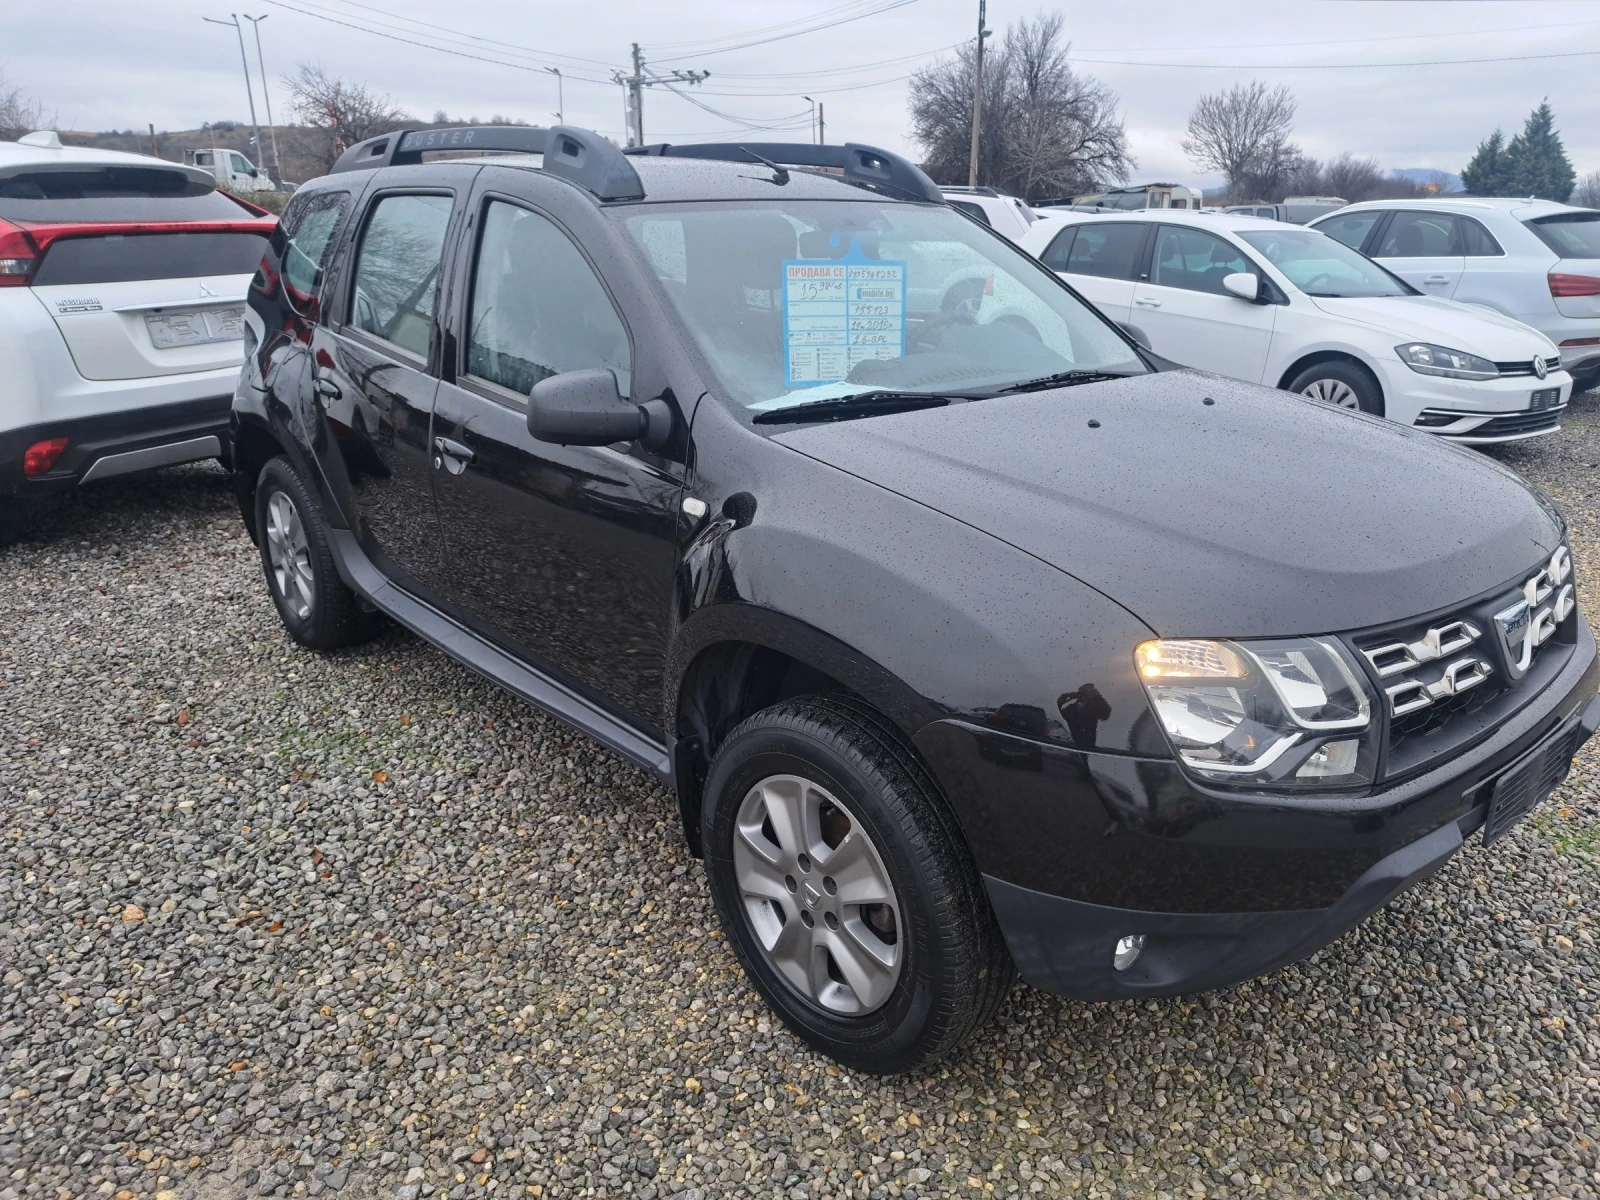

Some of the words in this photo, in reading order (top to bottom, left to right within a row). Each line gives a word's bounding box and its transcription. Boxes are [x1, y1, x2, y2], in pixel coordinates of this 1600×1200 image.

[404, 131, 475, 148] DUSTER
[789, 267, 830, 278] ПРОДАВА
[833, 267, 845, 277] СЕ
[862, 289, 894, 299] mobile.bg
